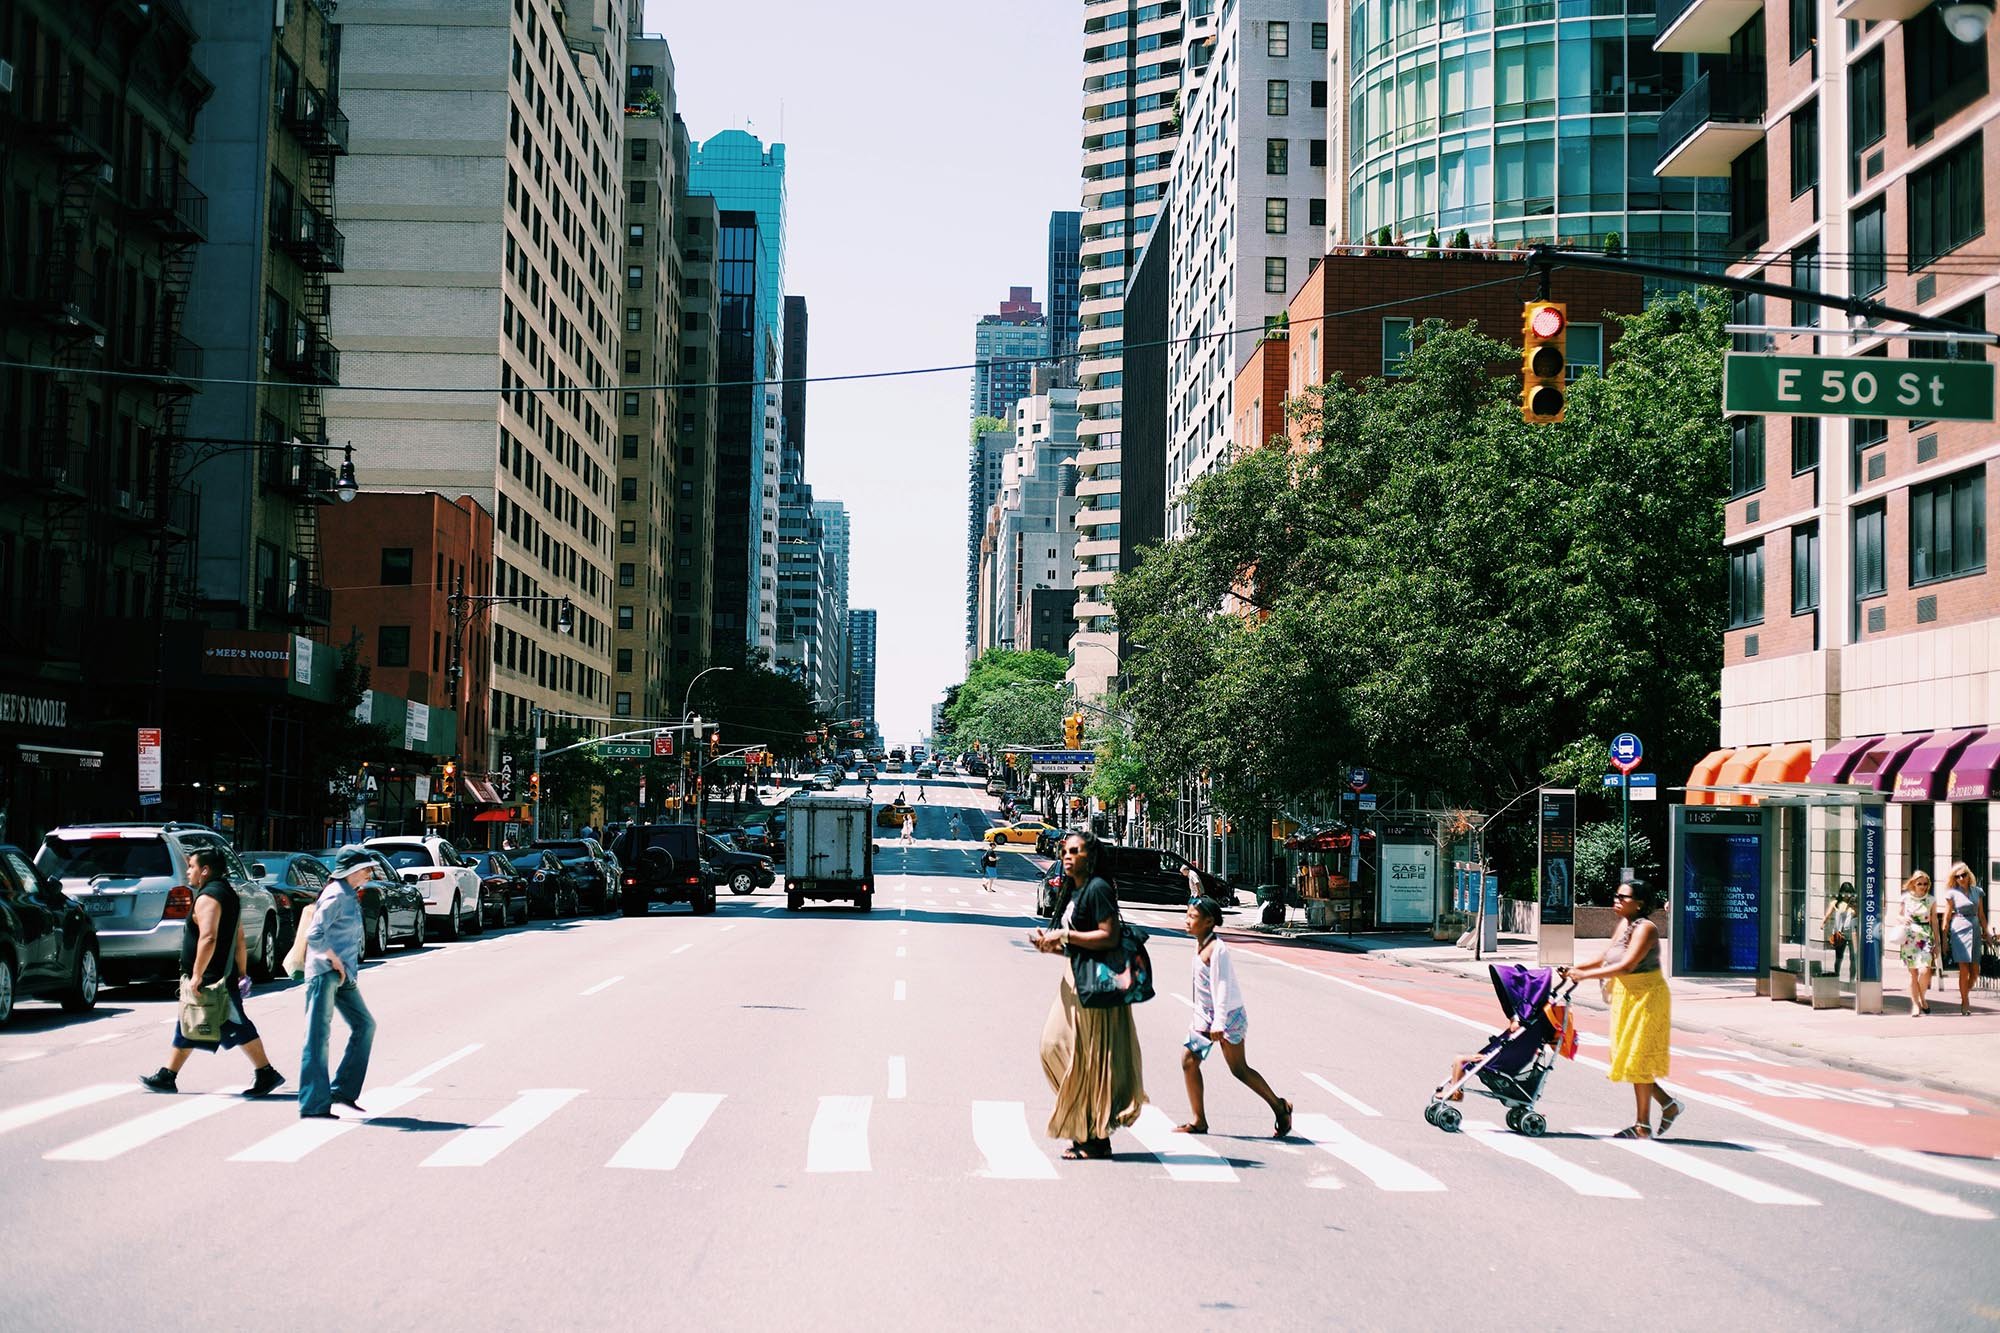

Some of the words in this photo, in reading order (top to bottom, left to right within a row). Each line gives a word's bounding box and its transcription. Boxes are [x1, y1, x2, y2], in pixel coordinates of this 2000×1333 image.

[1777, 368, 1802, 401] E
[1821, 370, 1878, 404] 50
[1897, 372, 1945, 407] St
[215, 648, 246, 657] MEE'S
[27, 697, 67, 728] NOODLE
[607, 746, 613, 754] E
[615, 746, 628, 754] 49
[630, 746, 641, 755] St
[1866, 829, 1876, 865] Avenue
[1391, 865, 1426, 873] CASH
[1391, 872, 1425, 880] 4LIFE
[1866, 877, 1876, 897] East
[1866, 900, 1875, 912] 50
[1866, 914, 1876, 944] Street
